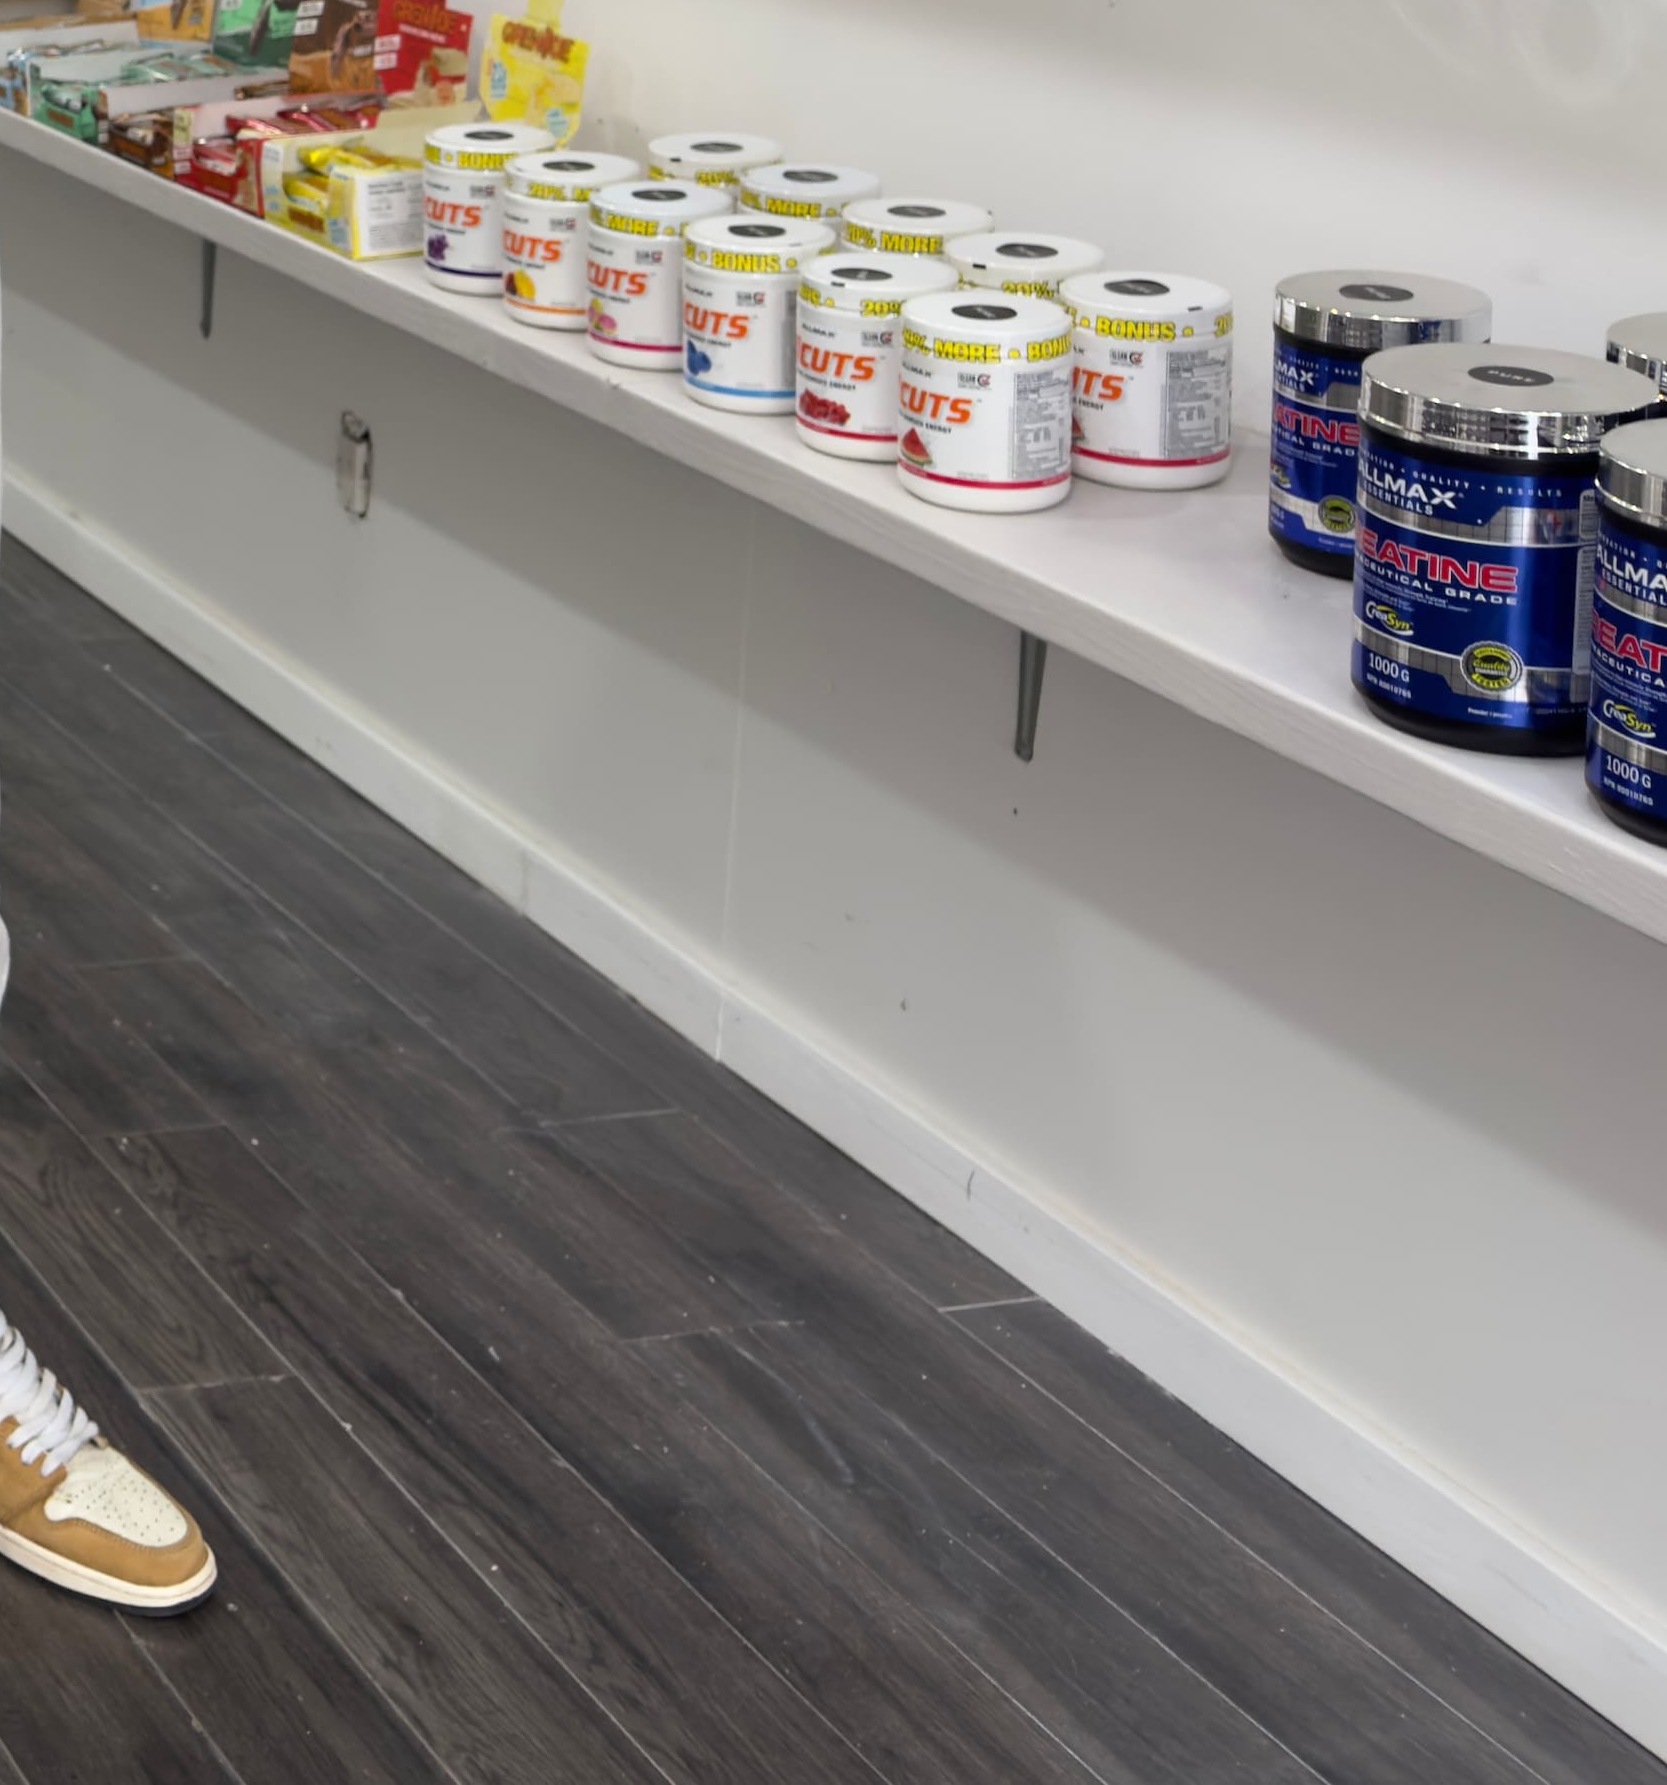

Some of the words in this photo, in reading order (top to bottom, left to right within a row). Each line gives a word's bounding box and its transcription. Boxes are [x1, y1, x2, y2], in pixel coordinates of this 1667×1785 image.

[881, 233, 942, 254] MORE
[712, 248, 781, 273] BONUS
[684, 301, 749, 340] CUTS
[1096, 316, 1177, 342] BONUS
[934, 338, 1001, 363] MORE
[899, 382, 973, 425] CUTS
[1497, 486, 1562, 498] RESULTS
[1445, 587, 1517, 605] GRADE
[1369, 652, 1399, 679] 1000
[1401, 669, 1410, 684] G
[1606, 754, 1639, 784] 1000
[1641, 773, 1651, 789] G
